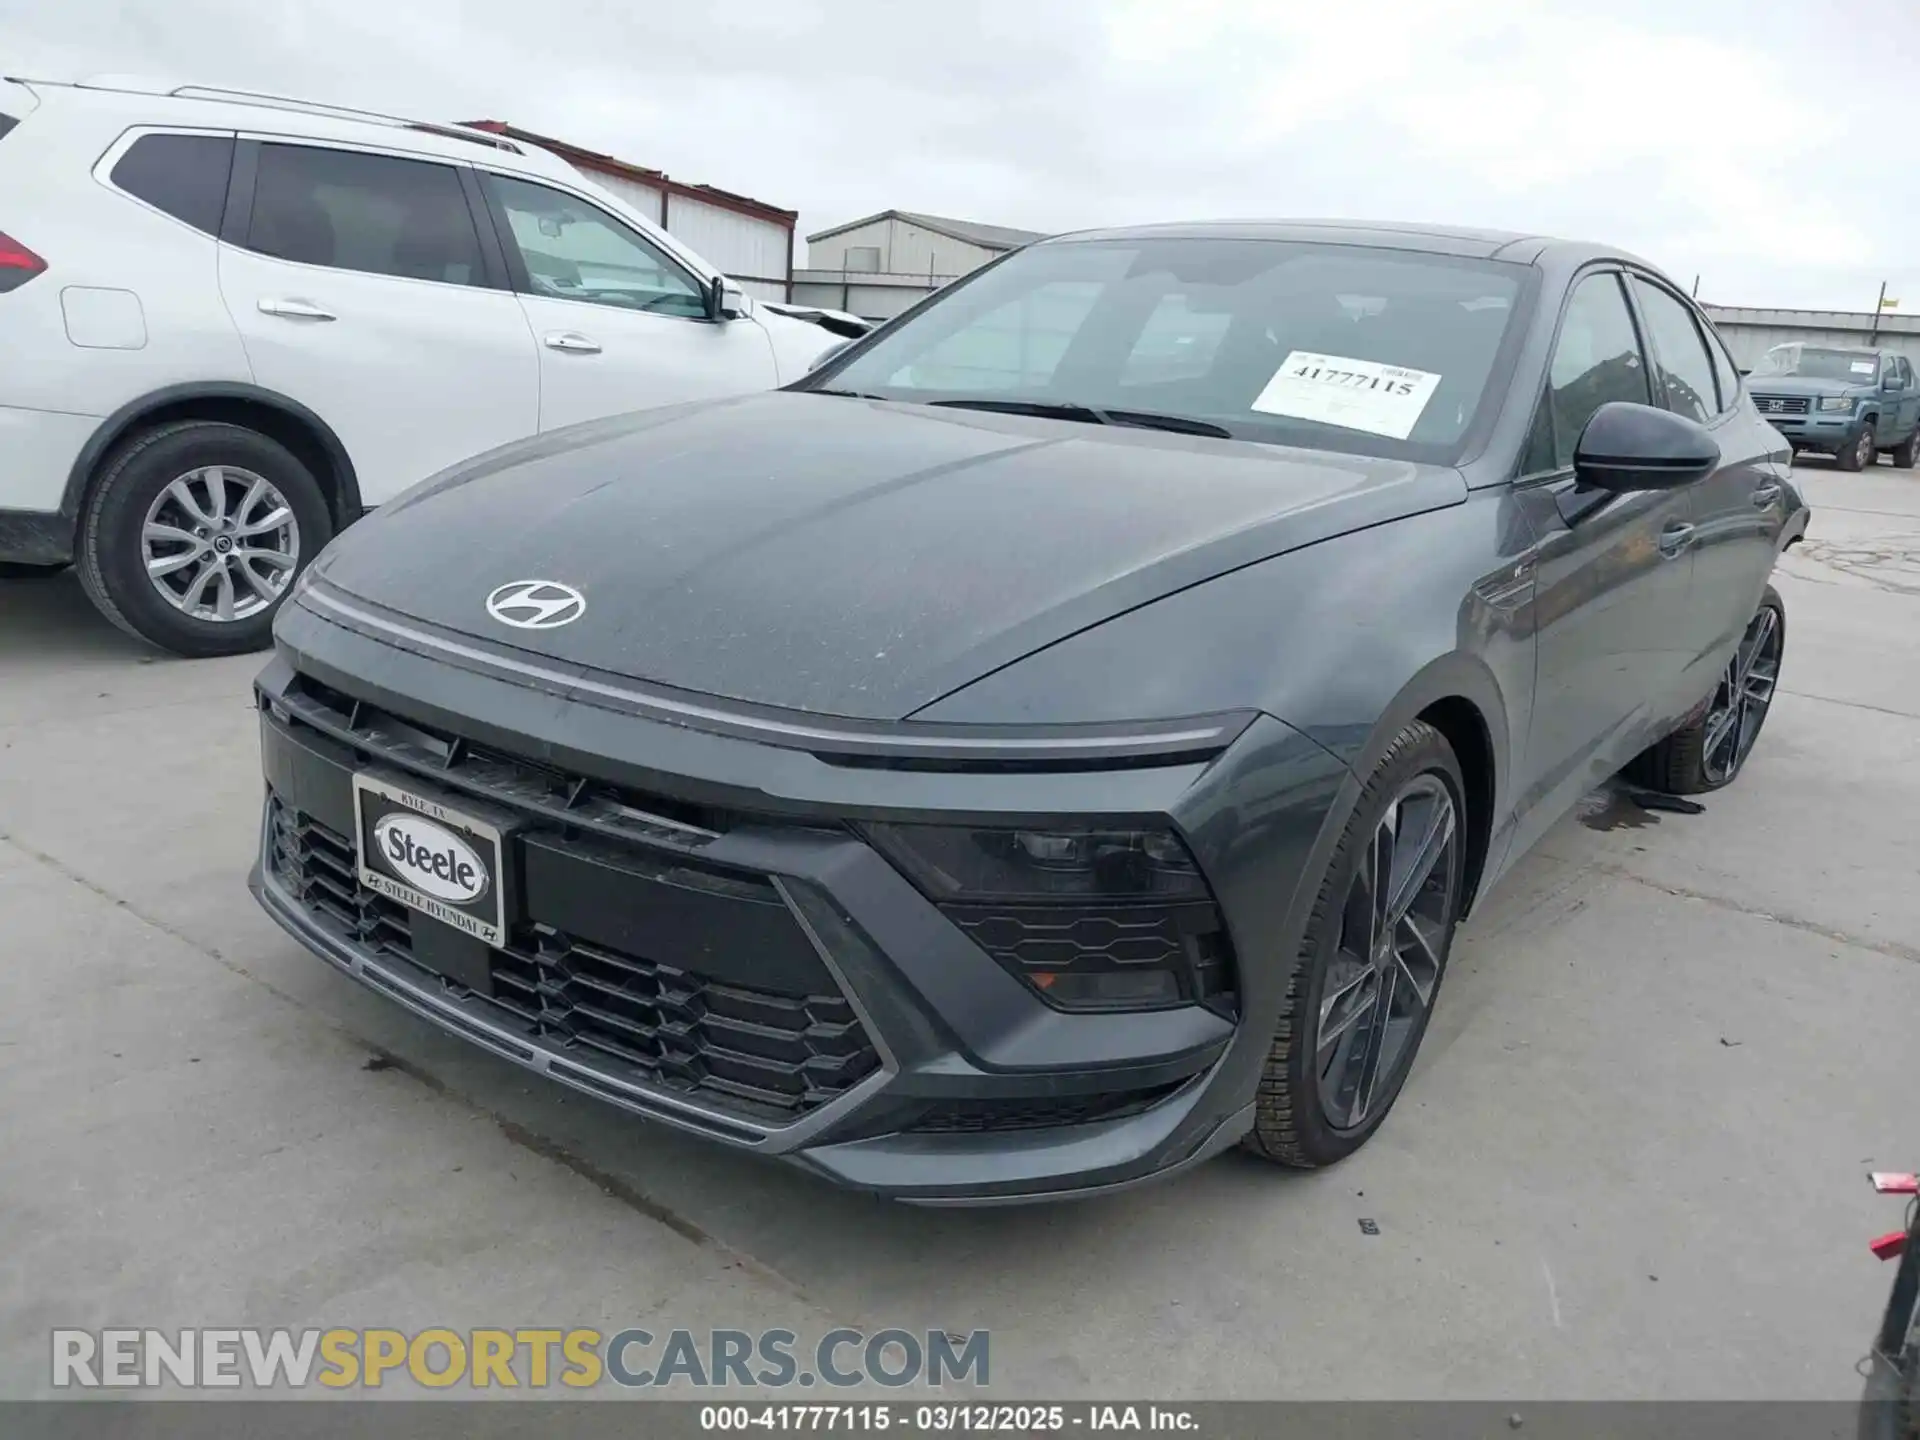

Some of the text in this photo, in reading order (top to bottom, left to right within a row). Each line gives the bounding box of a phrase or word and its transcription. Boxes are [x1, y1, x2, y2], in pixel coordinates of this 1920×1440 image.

[1293, 366, 1416, 396] 41777115
[388, 826, 475, 892] Steele
[384, 880, 477, 933] STEELE HYUNDAI
